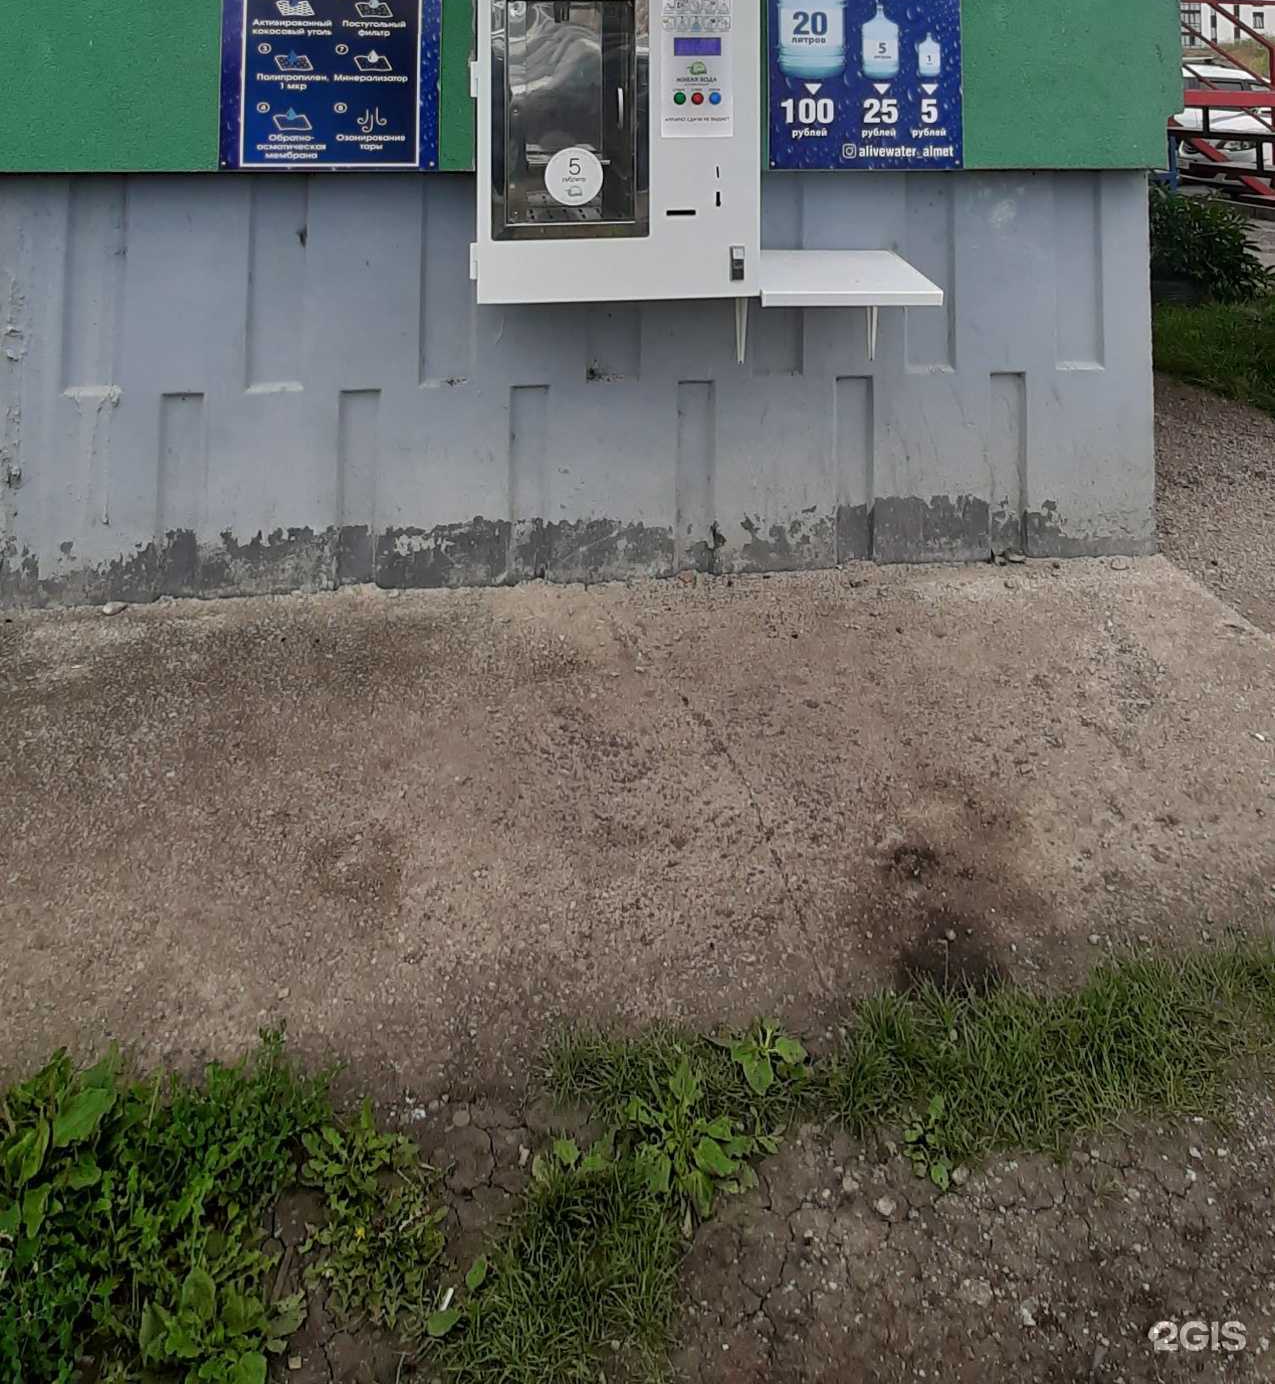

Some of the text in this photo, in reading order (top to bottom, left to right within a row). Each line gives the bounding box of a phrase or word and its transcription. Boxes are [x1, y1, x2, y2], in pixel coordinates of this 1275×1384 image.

[252, 18, 333, 28] Активированный
[792, 11, 828, 36] 20
[307, 28, 333, 37] уголь
[358, 29, 391, 38] фильтр
[791, 36, 826, 45] литров
[878, 42, 887, 54] 5
[926, 54, 932, 62] 1
[334, 73, 408, 84] Минерализатор
[287, 83, 307, 91] мкр
[780, 98, 835, 124] 100
[863, 98, 898, 124] 25
[920, 98, 938, 124] 5
[791, 127, 828, 138] рублей
[861, 127, 897, 138] рублей
[912, 127, 947, 138] рублей
[336, 134, 406, 143] Озонирование
[360, 143, 383, 151] тары
[858, 145, 954, 159] alivewater_almet
[568, 157, 581, 176] 5
